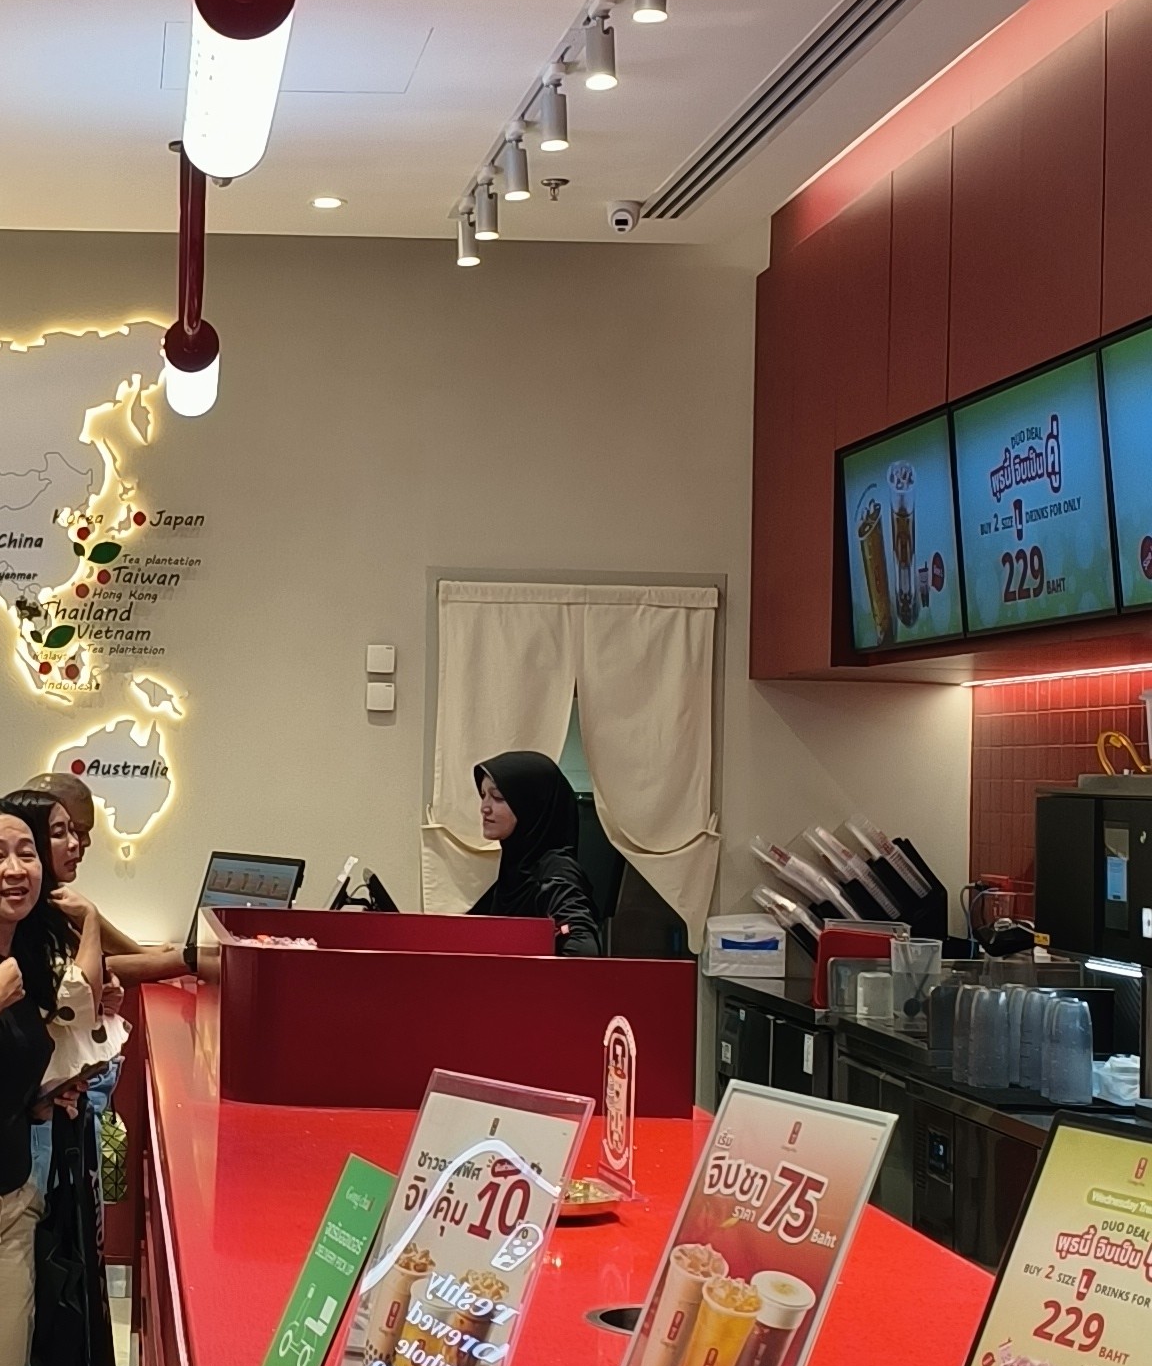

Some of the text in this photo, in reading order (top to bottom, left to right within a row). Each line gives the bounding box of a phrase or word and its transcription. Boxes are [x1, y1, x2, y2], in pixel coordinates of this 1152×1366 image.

[1011, 427, 1043, 449] DUO DEAL
[149, 510, 205, 531] Japan
[993, 513, 1000, 532] 2
[1025, 505, 1049, 524] DRINKS
[1049, 502, 1063, 518] FOR
[1063, 496, 1082, 513] ONLY
[122, 554, 202, 567] Tea plantation
[112, 566, 181, 586] Taiwan
[1001, 546, 1066, 603] 229 BAHT
[92, 590, 158, 603] Hong Kong
[40, 598, 134, 622] Thailand
[77, 624, 151, 641] Vietnam
[87, 643, 165, 656] Tea plantation
[86, 758, 169, 778] Australia
[759, 1163, 826, 1241] 75
[810, 1228, 837, 1249] Baht
[1101, 1220, 1151, 1242] DUO DEAL
[1023, 1263, 1043, 1277] BUY
[1044, 1265, 1056, 1280] 2
[1056, 1272, 1077, 1287] SIZE
[1094, 1283, 1130, 1303] DRINKS
[1131, 1292, 1152, 1309] FOR
[1032, 1299, 1130, 1366] 229 BAHT
